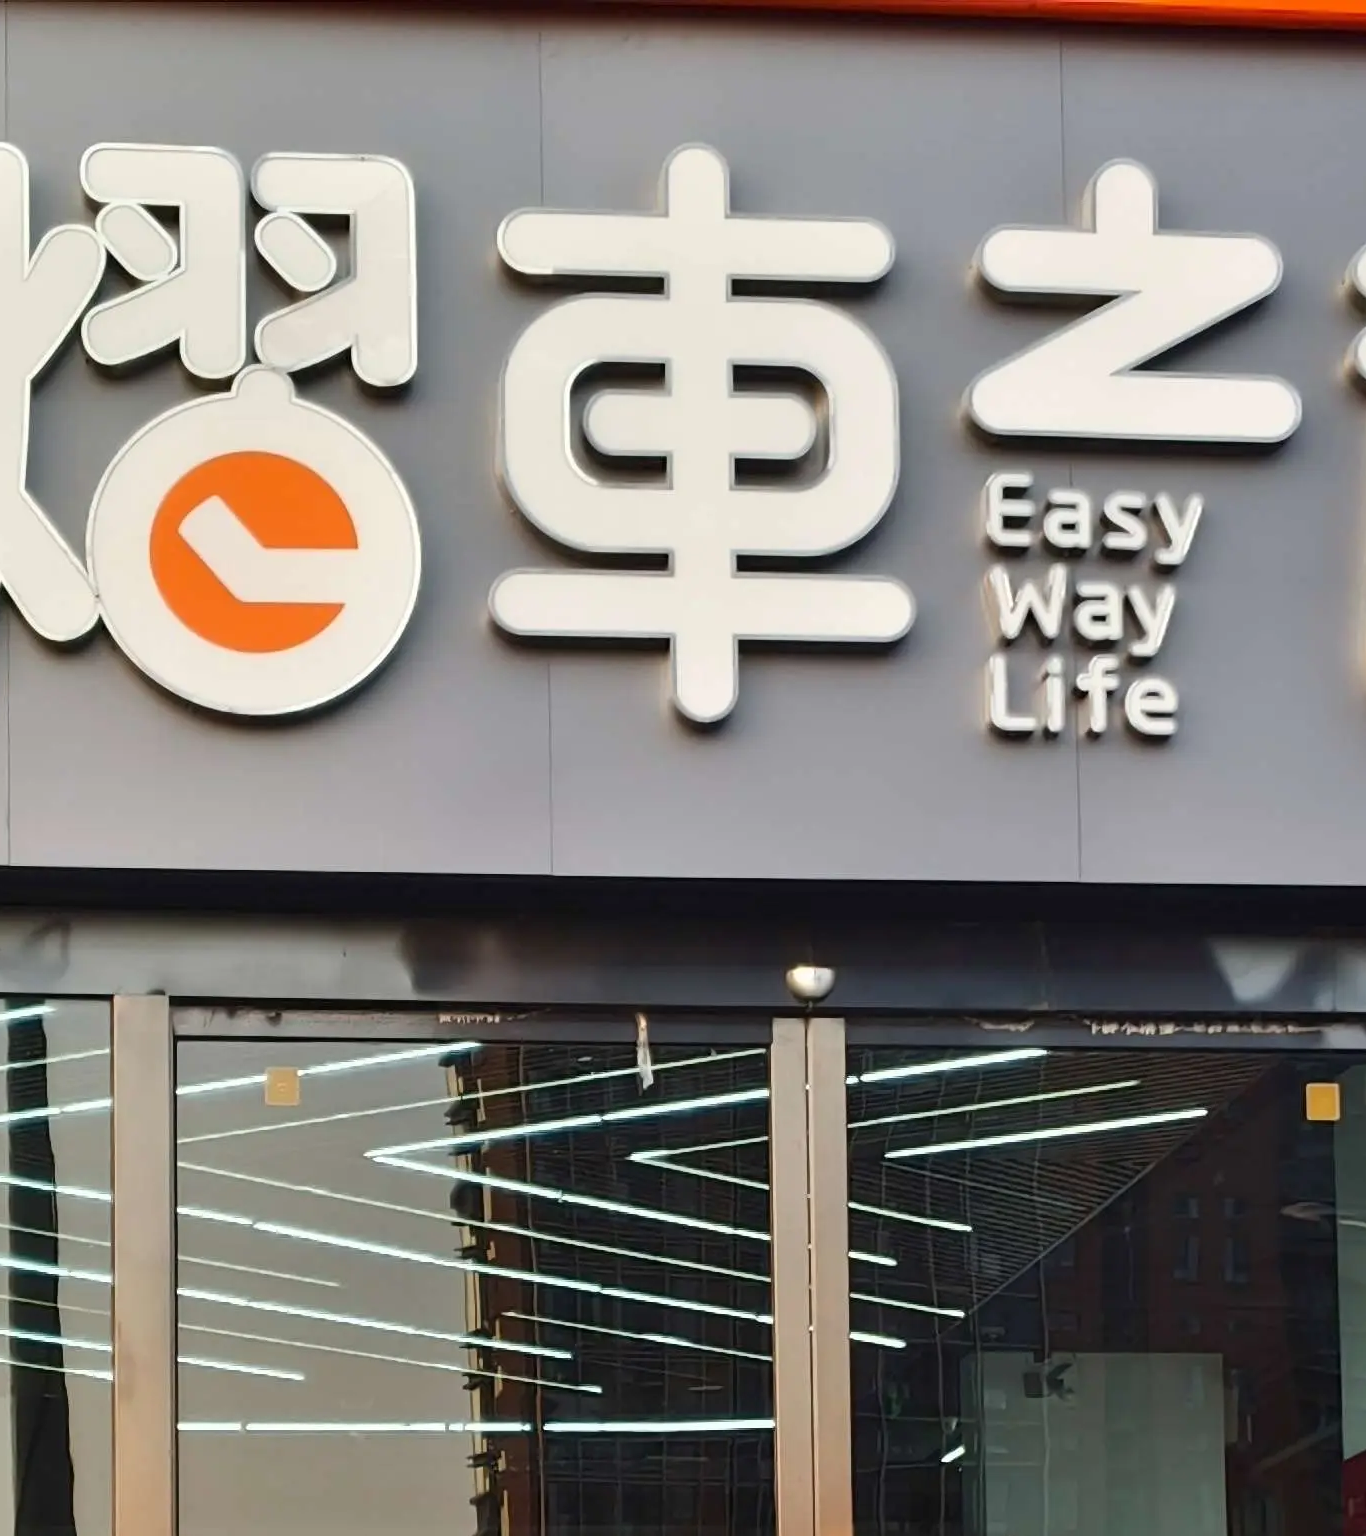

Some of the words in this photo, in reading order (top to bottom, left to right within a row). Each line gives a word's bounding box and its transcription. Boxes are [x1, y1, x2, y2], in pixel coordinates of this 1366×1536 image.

[986, 472, 1204, 565] Easy
[987, 562, 1176, 657] Way
[988, 653, 1179, 735] Life
